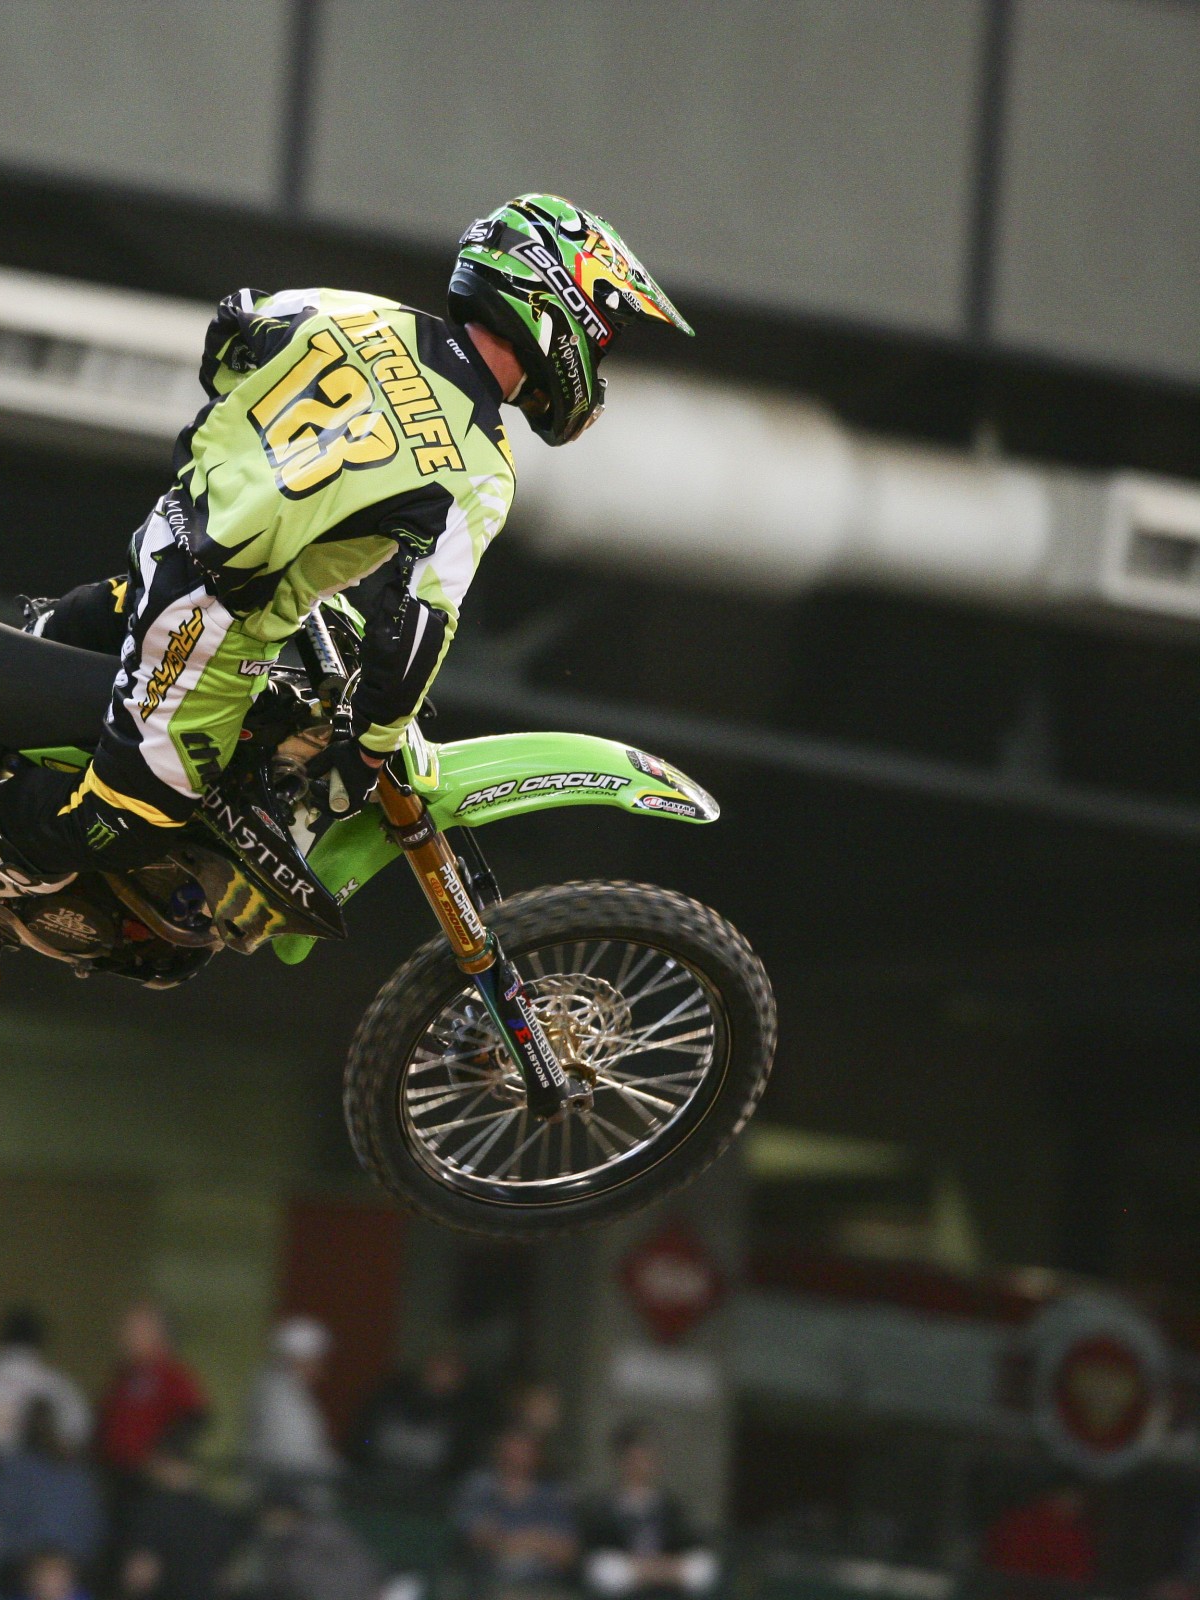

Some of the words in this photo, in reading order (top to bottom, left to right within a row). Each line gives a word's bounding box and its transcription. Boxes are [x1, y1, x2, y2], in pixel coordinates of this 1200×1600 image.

[582, 227, 630, 282] 123
[523, 245, 609, 341] SCOTT
[557, 334, 584, 405] MONSTER
[247, 328, 400, 501] 123
[238, 659, 278, 677] VAN
[453, 780, 518, 814] PRO
[517, 771, 632, 793] CIRCUIT
[201, 783, 316, 909] ONSTER
[440, 862, 458, 892] PRO
[451, 890, 487, 941] CIRCUIT
[440, 901, 471, 947] SHOWA
[524, 1041, 551, 1089] PISTONS
